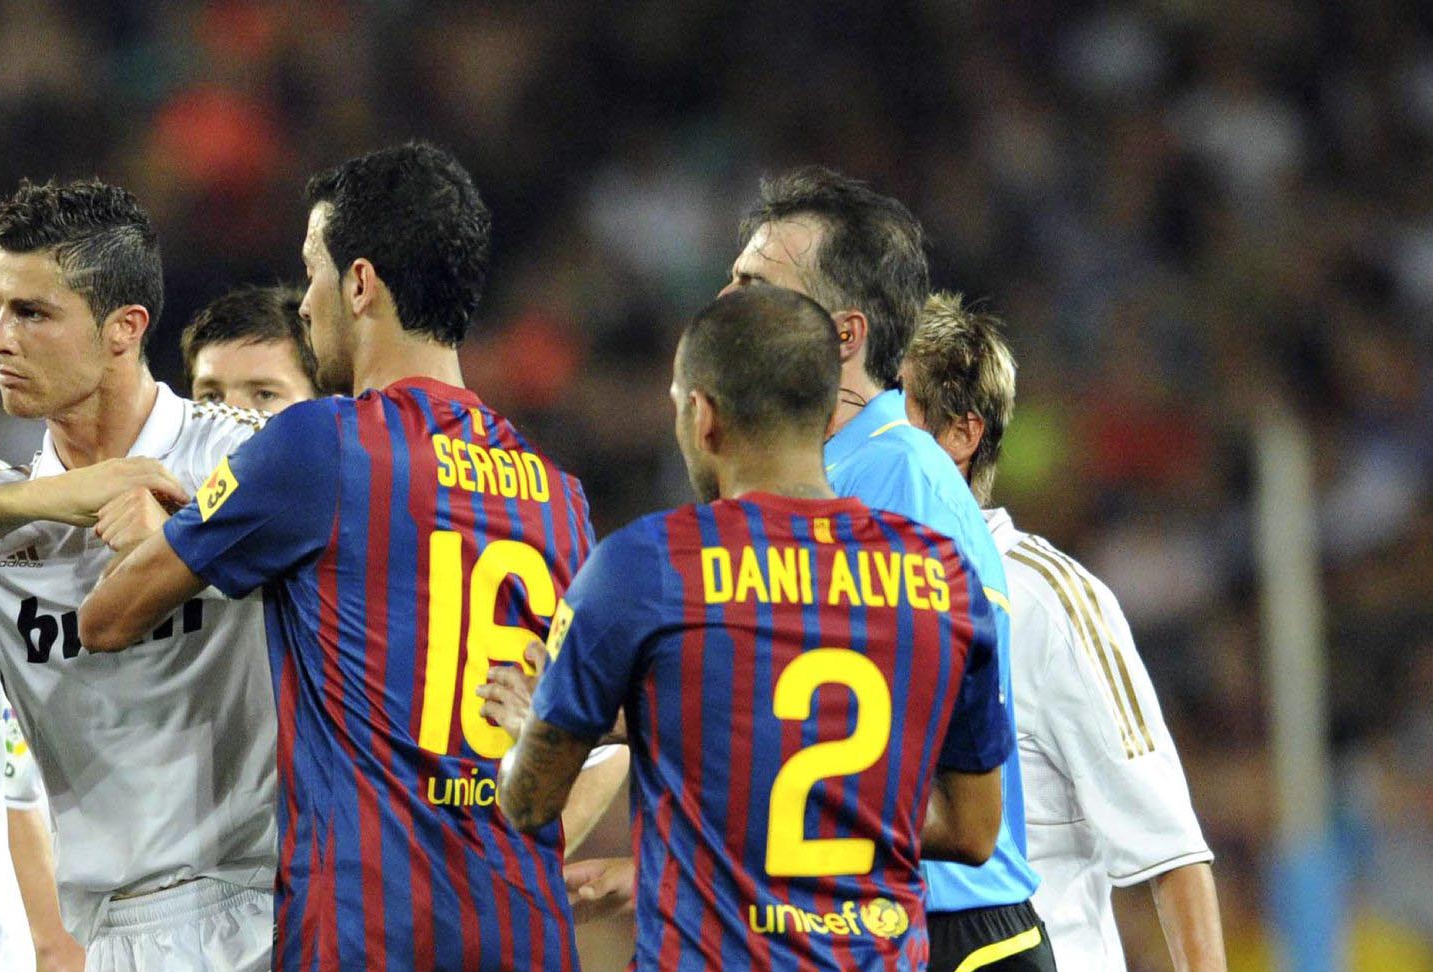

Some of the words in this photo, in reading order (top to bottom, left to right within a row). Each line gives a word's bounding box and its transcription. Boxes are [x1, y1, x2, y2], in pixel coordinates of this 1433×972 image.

[432, 434, 551, 503] SERGIO
[700, 546, 814, 605] DANI
[827, 550, 951, 612] ALVES
[418, 530, 557, 759] 16
[765, 647, 892, 877] 2
[749, 900, 859, 937] unicef
